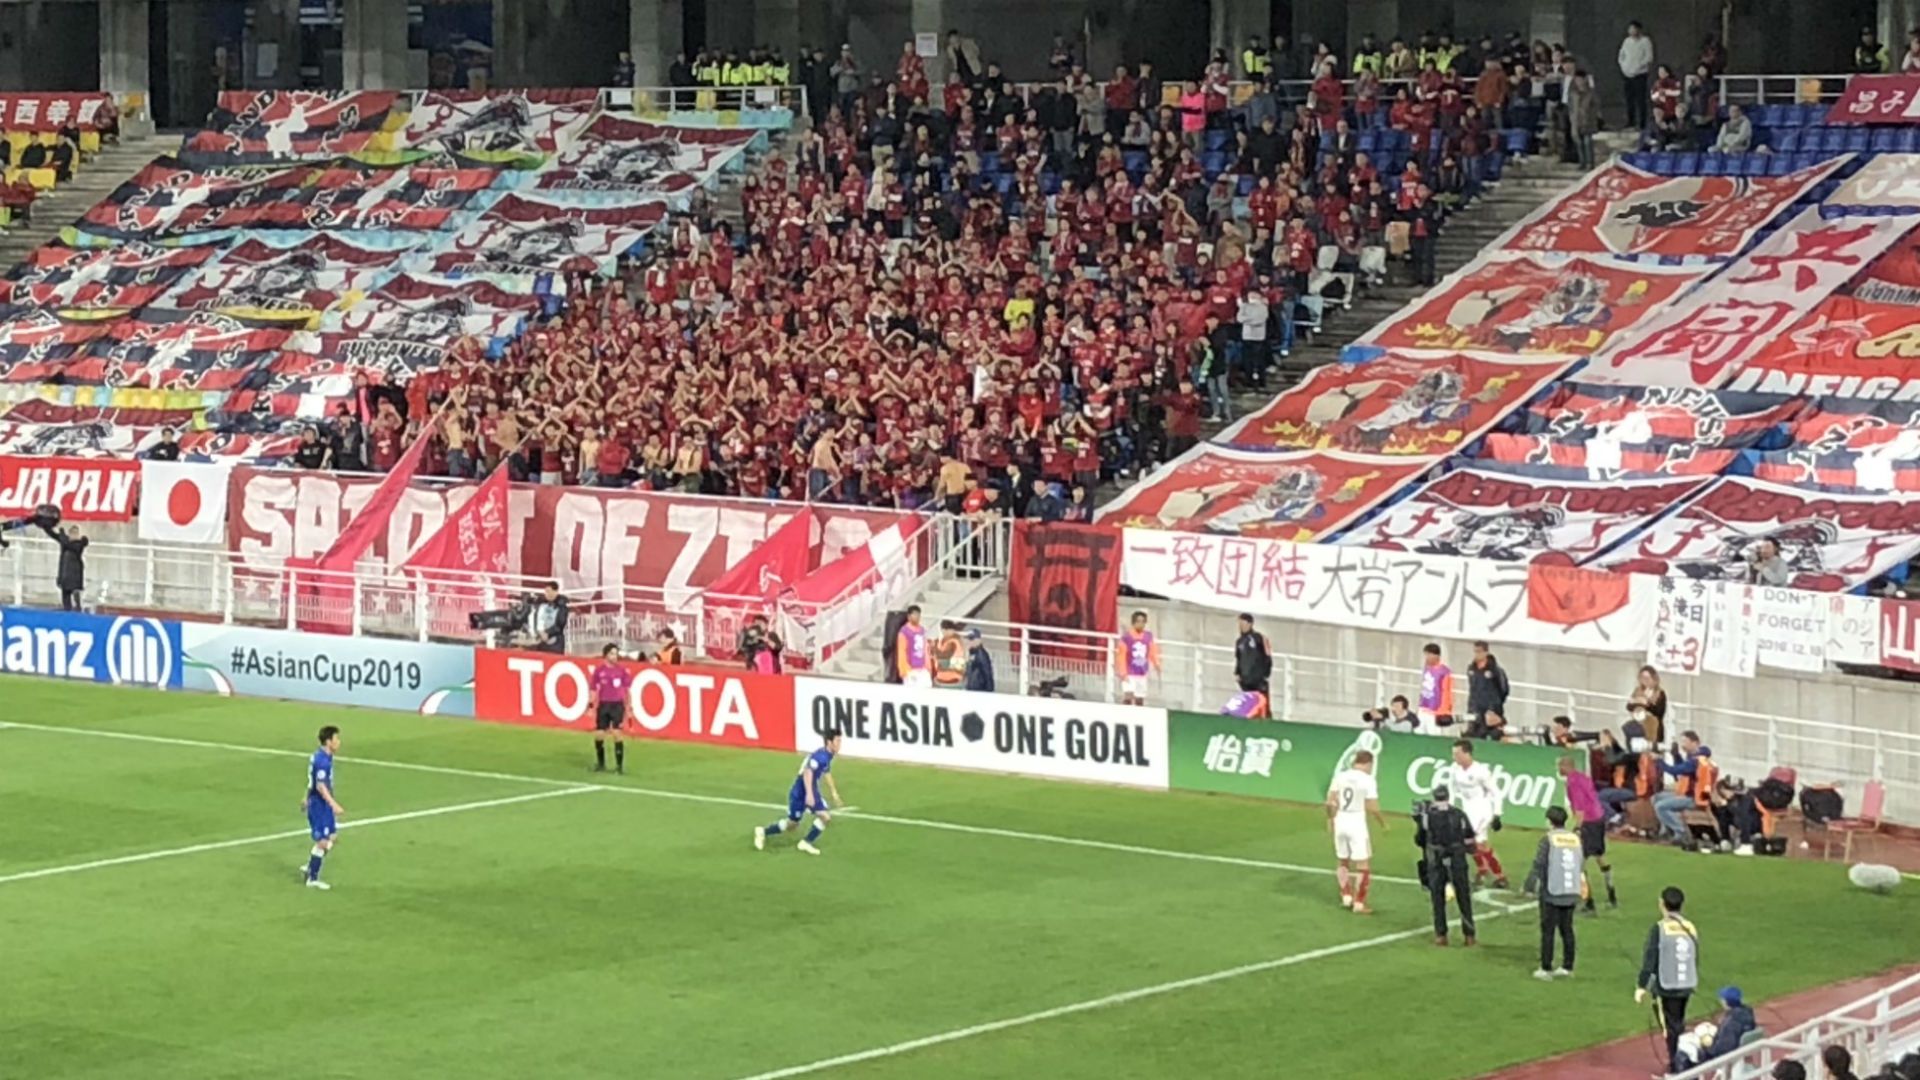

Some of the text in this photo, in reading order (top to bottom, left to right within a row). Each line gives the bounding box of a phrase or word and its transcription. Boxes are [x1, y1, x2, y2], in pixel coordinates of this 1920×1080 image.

[0, 467, 136, 513] JAPAN
[543, 492, 649, 604] OF
[1130, 536, 1310, 600] 一致団結
[1757, 613, 1826, 633] FORGET
[231, 645, 422, 691] #AsianCup2019
[507, 657, 759, 740] TOOTA
[812, 695, 1150, 767] ONE ASIA ONE GOAL
[1343, 787, 1354, 812] 9
